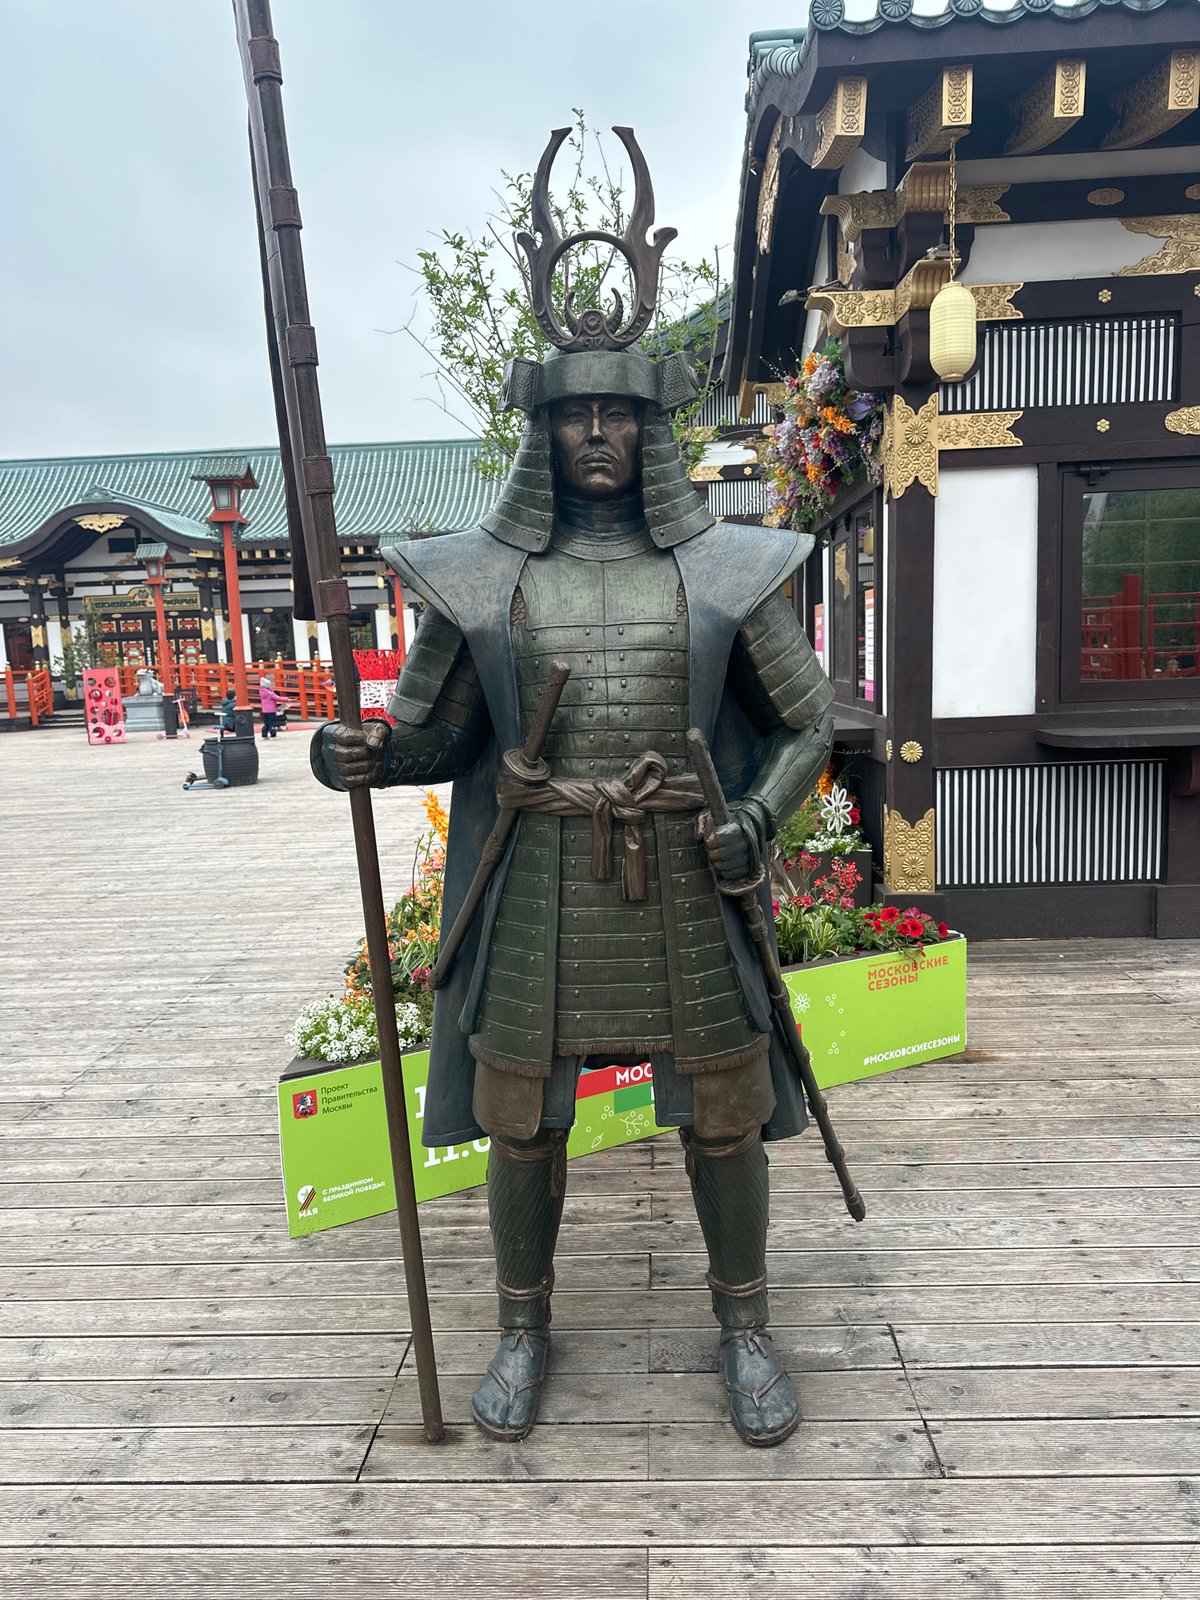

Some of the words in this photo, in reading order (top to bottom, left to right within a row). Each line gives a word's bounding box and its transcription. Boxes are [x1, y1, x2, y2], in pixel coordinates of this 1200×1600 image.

[868, 956, 949, 981] МОСКОВСКИЕ
[868, 973, 918, 991] СЕЗОНЫ
[863, 1034, 960, 1066] #МОСКОВСКИЕСЕЗОНЫ
[321, 1083, 348, 1094] Проект
[322, 1087, 378, 1105] Правительства
[322, 1103, 353, 1114] Москвы
[329, 1177, 373, 1194] ПРАЗДНИКОМ
[323, 1190, 354, 1203] ВЕЛИКОЙ
[299, 1207, 319, 1219] МАЯ
